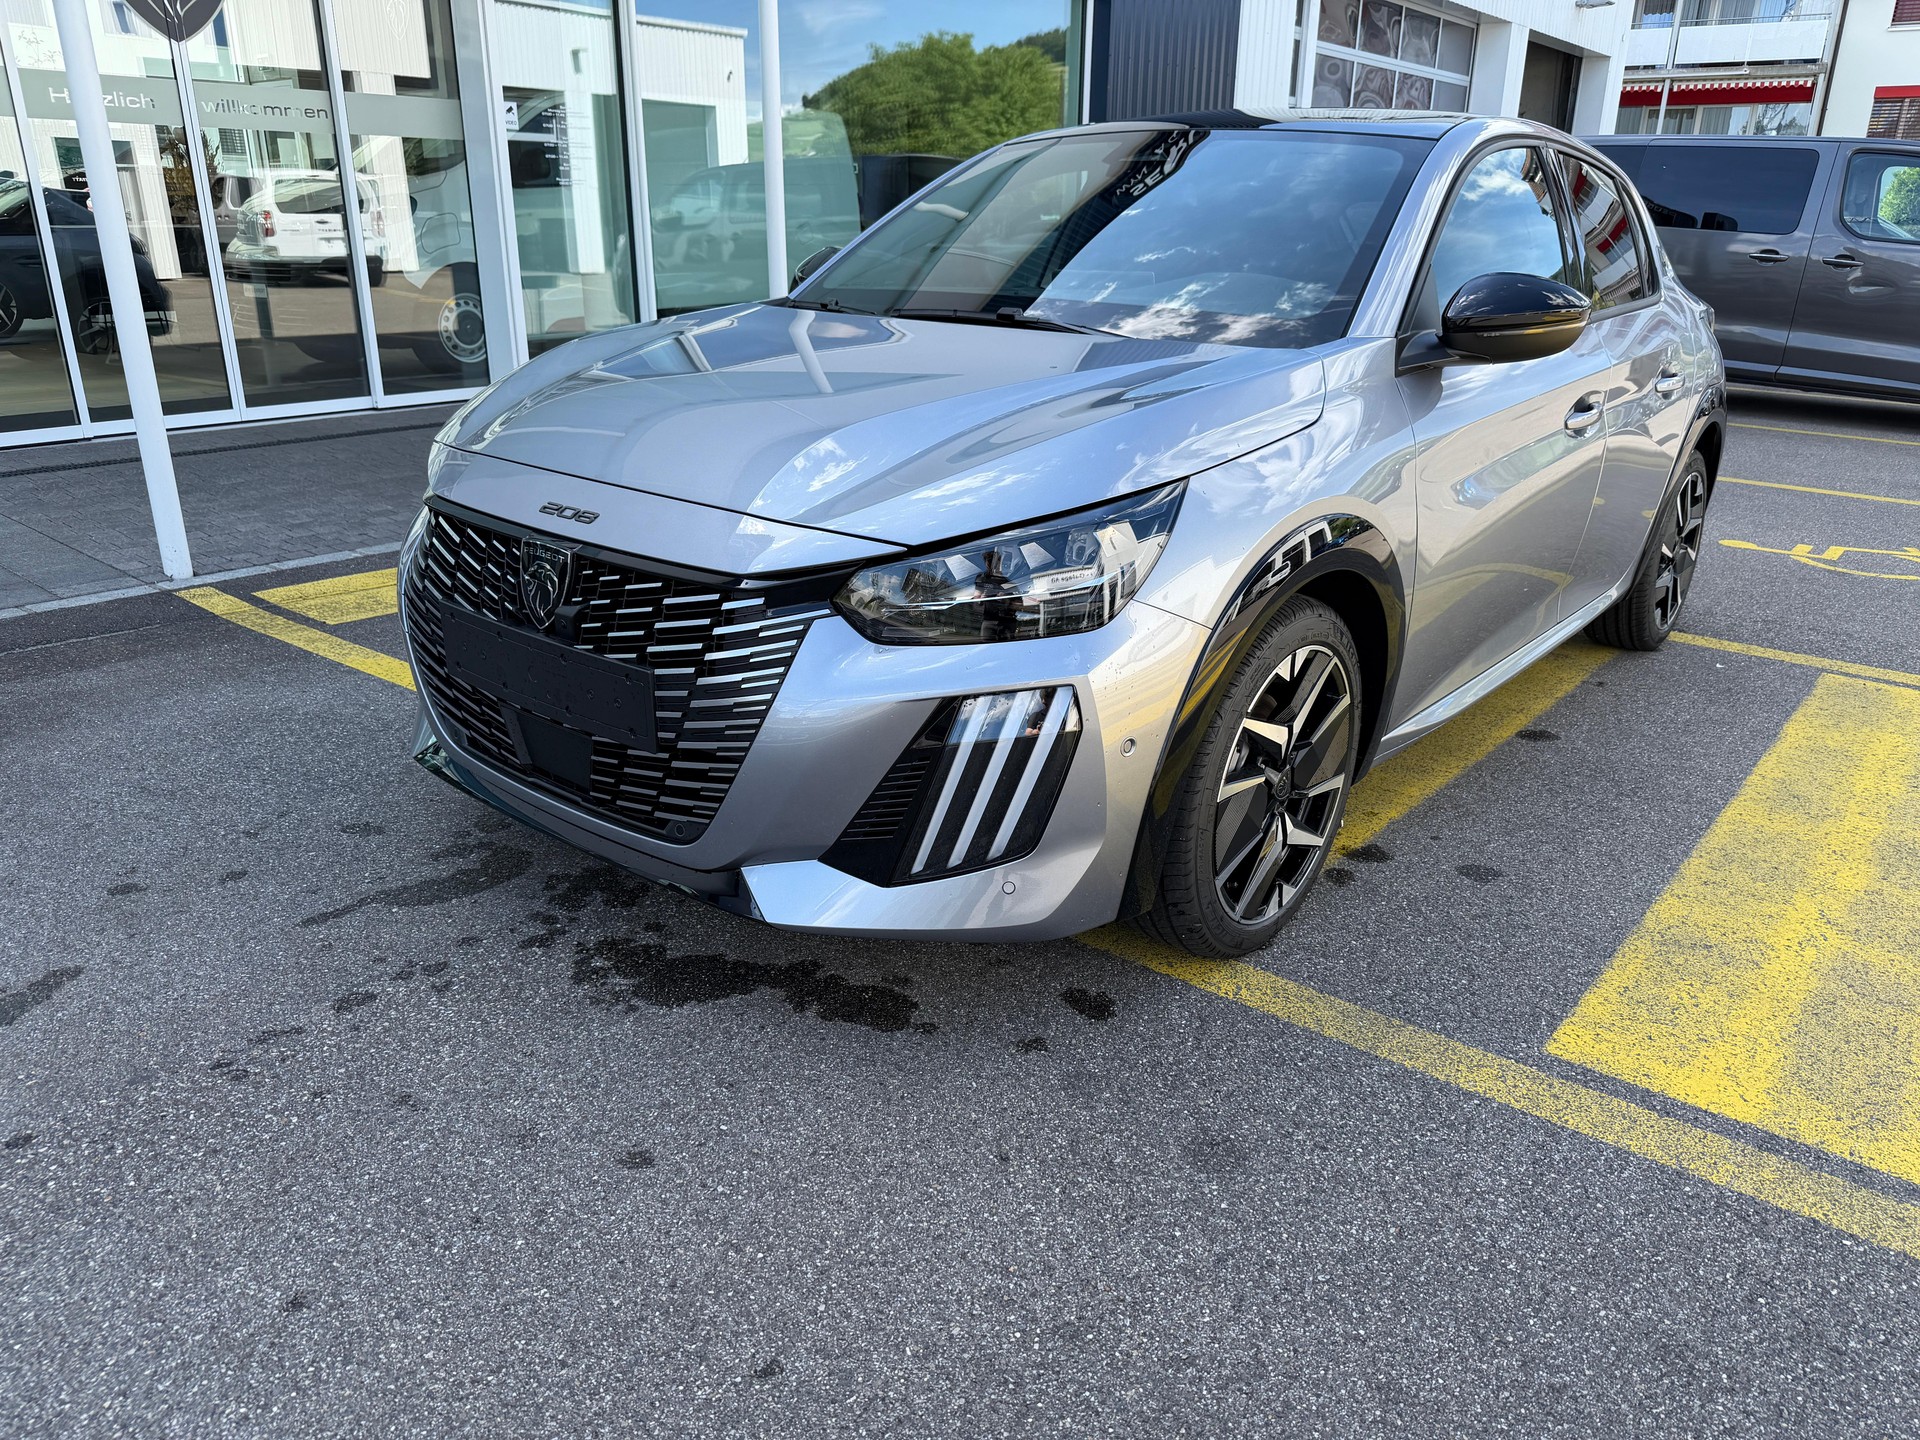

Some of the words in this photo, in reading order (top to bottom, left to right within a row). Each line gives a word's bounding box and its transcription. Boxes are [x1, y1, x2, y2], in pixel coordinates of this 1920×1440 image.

[48, 86, 156, 109] Hzlich
[200, 97, 329, 119] willkommen
[538, 500, 601, 525] 208
[523, 545, 566, 563] PEUGEOT
